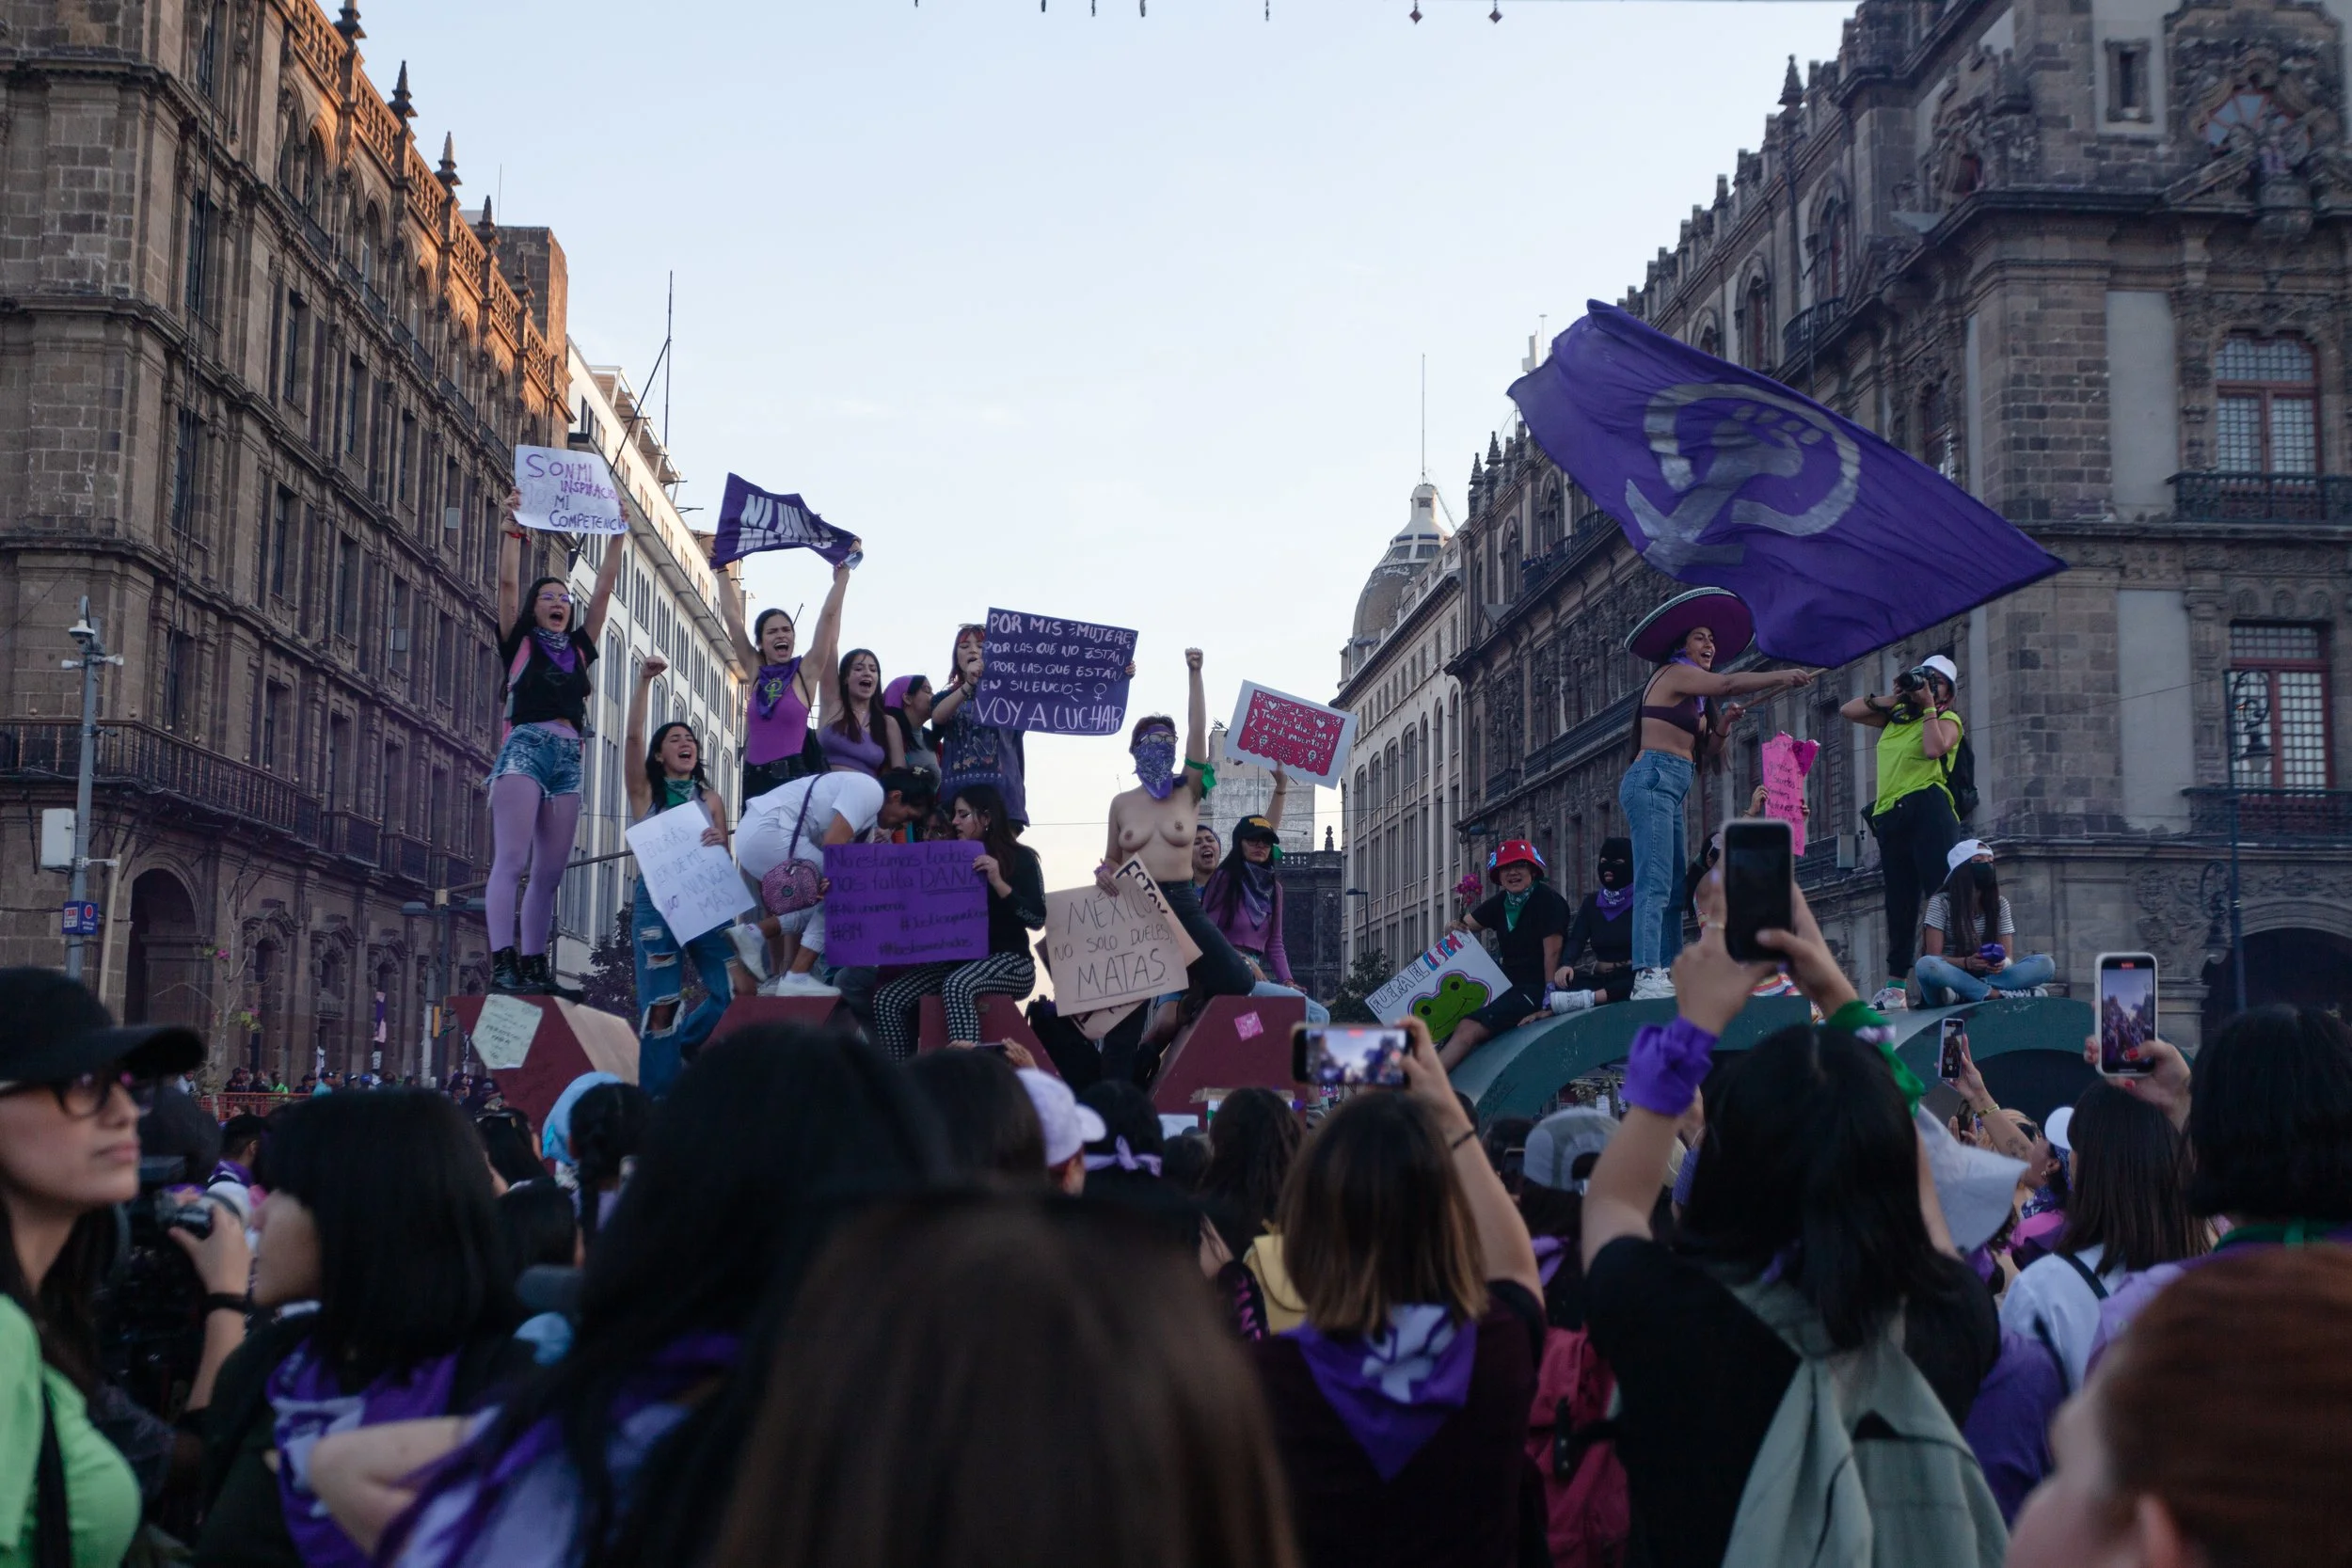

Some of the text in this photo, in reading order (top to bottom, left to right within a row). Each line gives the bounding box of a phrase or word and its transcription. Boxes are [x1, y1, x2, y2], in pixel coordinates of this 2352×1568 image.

[554, 495, 570, 511] MI
[740, 494, 773, 529] NI
[990, 612, 1023, 634] POR
[1029, 617, 1063, 636] MIS
[984, 641, 1010, 653] POR
[1014, 642, 1033, 654] LAS
[1036, 642, 1058, 656] QUE
[1061, 645, 1080, 656] NO
[990, 660, 1016, 673] POR
[1022, 663, 1042, 674] LAS
[1045, 664, 1071, 675] QUE
[981, 679, 1074, 695] EN SILENCIO
[976, 697, 1124, 731] VOY A LUCHAR
[1281, 716, 1292, 727] los
[1312, 729, 1327, 740] son
[1068, 887, 1152, 935] MÉXICO
[1054, 945, 1073, 961] NO
[1087, 935, 1118, 954] SOLO
[1369, 974, 1416, 1014] FUERA
[1407, 962, 1430, 983] EL
